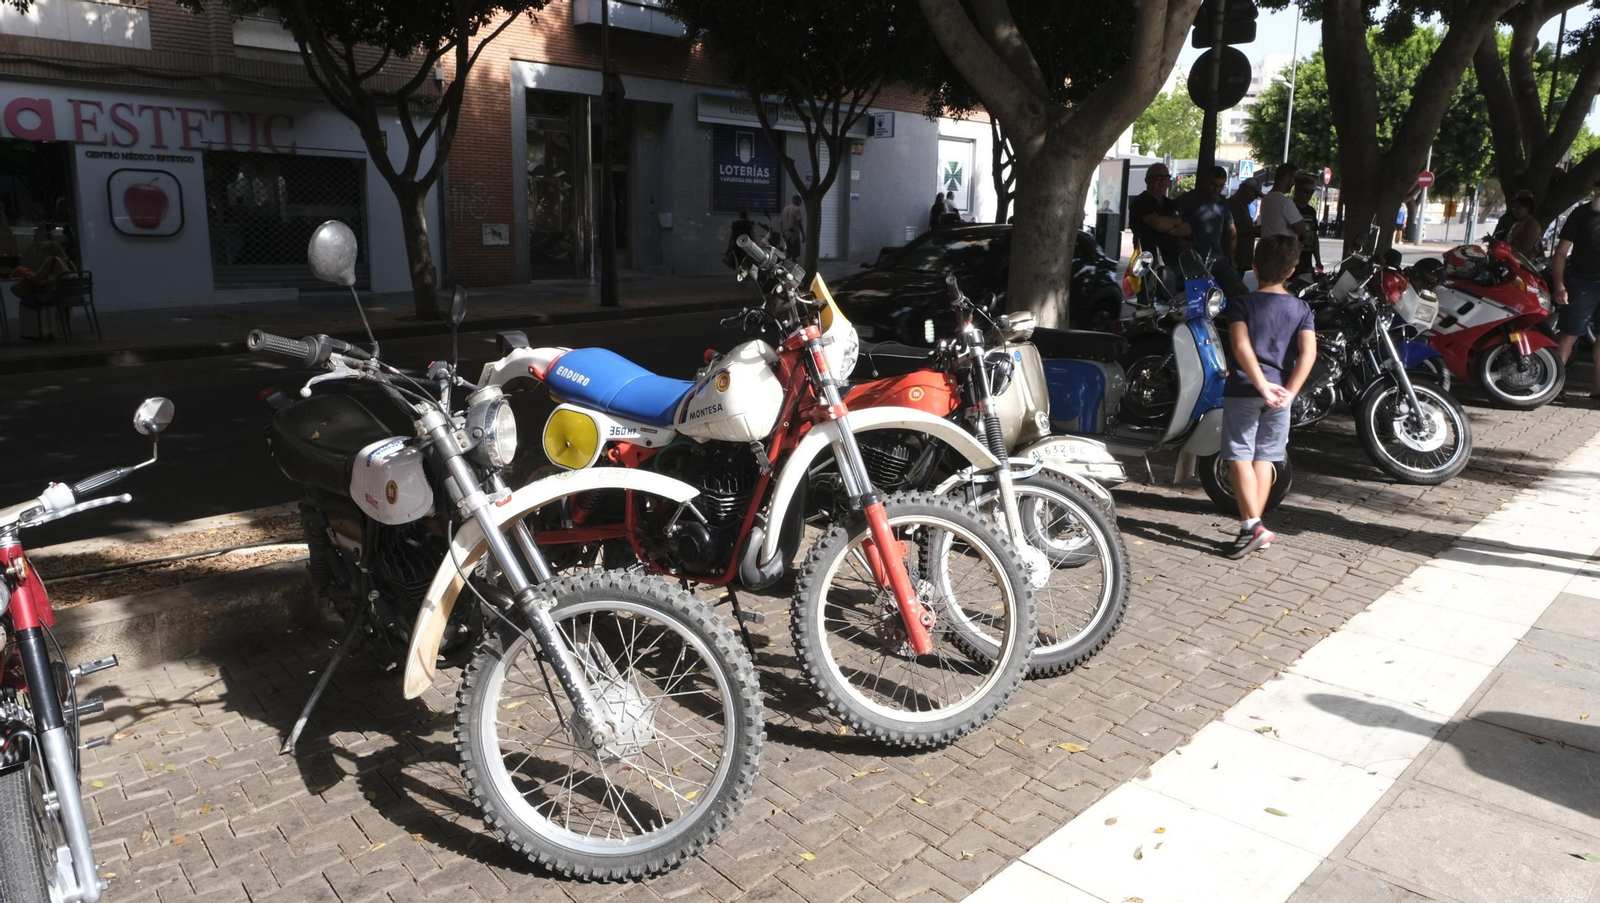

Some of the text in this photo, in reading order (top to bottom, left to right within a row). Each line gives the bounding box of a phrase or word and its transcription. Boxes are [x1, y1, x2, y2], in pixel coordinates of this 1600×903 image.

[67, 98, 297, 154] ESTETIC
[85, 151, 120, 159] CENTRO
[719, 164, 770, 178] LOTERÍAS
[555, 365, 591, 387] ENDURO
[689, 403, 724, 421] MONTESA
[609, 425, 627, 436] 360
[1044, 444, 1076, 455] 6328
